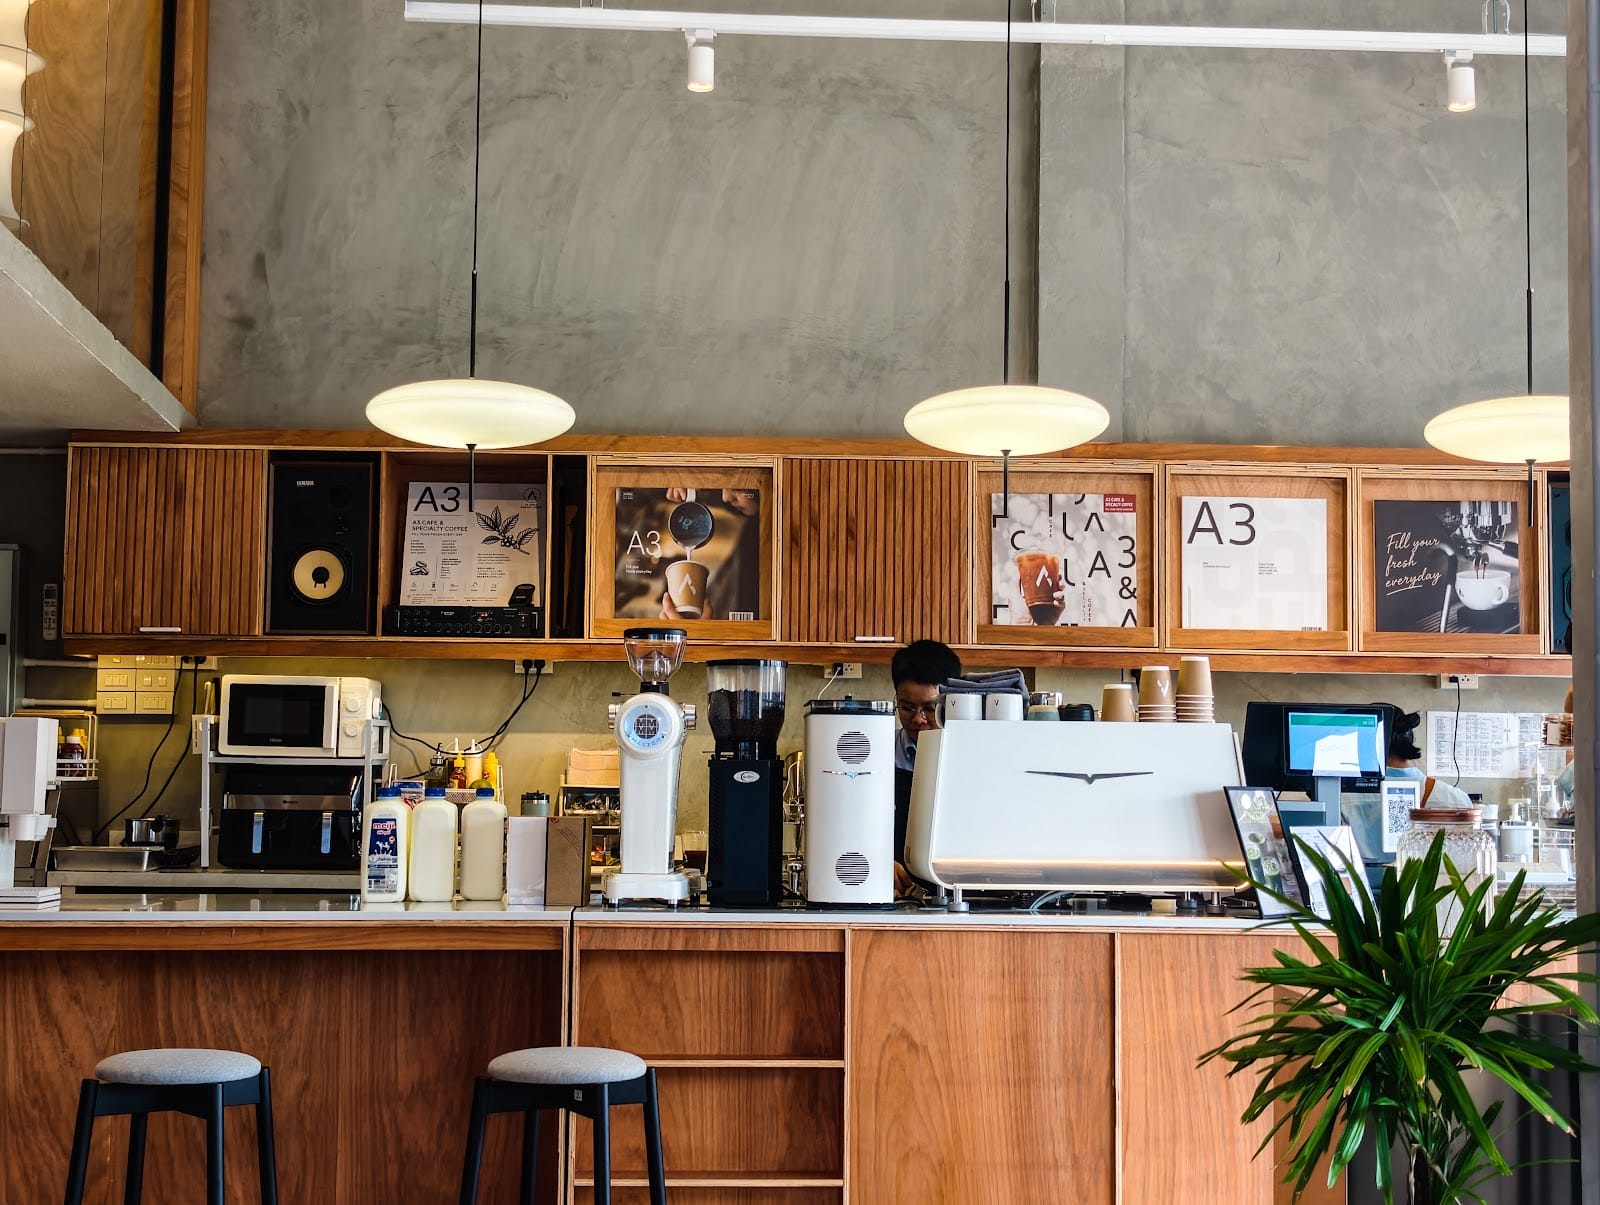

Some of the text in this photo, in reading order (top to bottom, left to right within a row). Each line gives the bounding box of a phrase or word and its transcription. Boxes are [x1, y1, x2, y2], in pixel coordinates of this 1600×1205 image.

[413, 486, 461, 513] A3
[1187, 501, 1256, 545] A3
[625, 530, 661, 557] A3
[1386, 532, 1440, 555] Fill your
[1385, 553, 1417, 577] fresh
[1385, 567, 1442, 588] everyday
[372, 823, 397, 831] meiji
